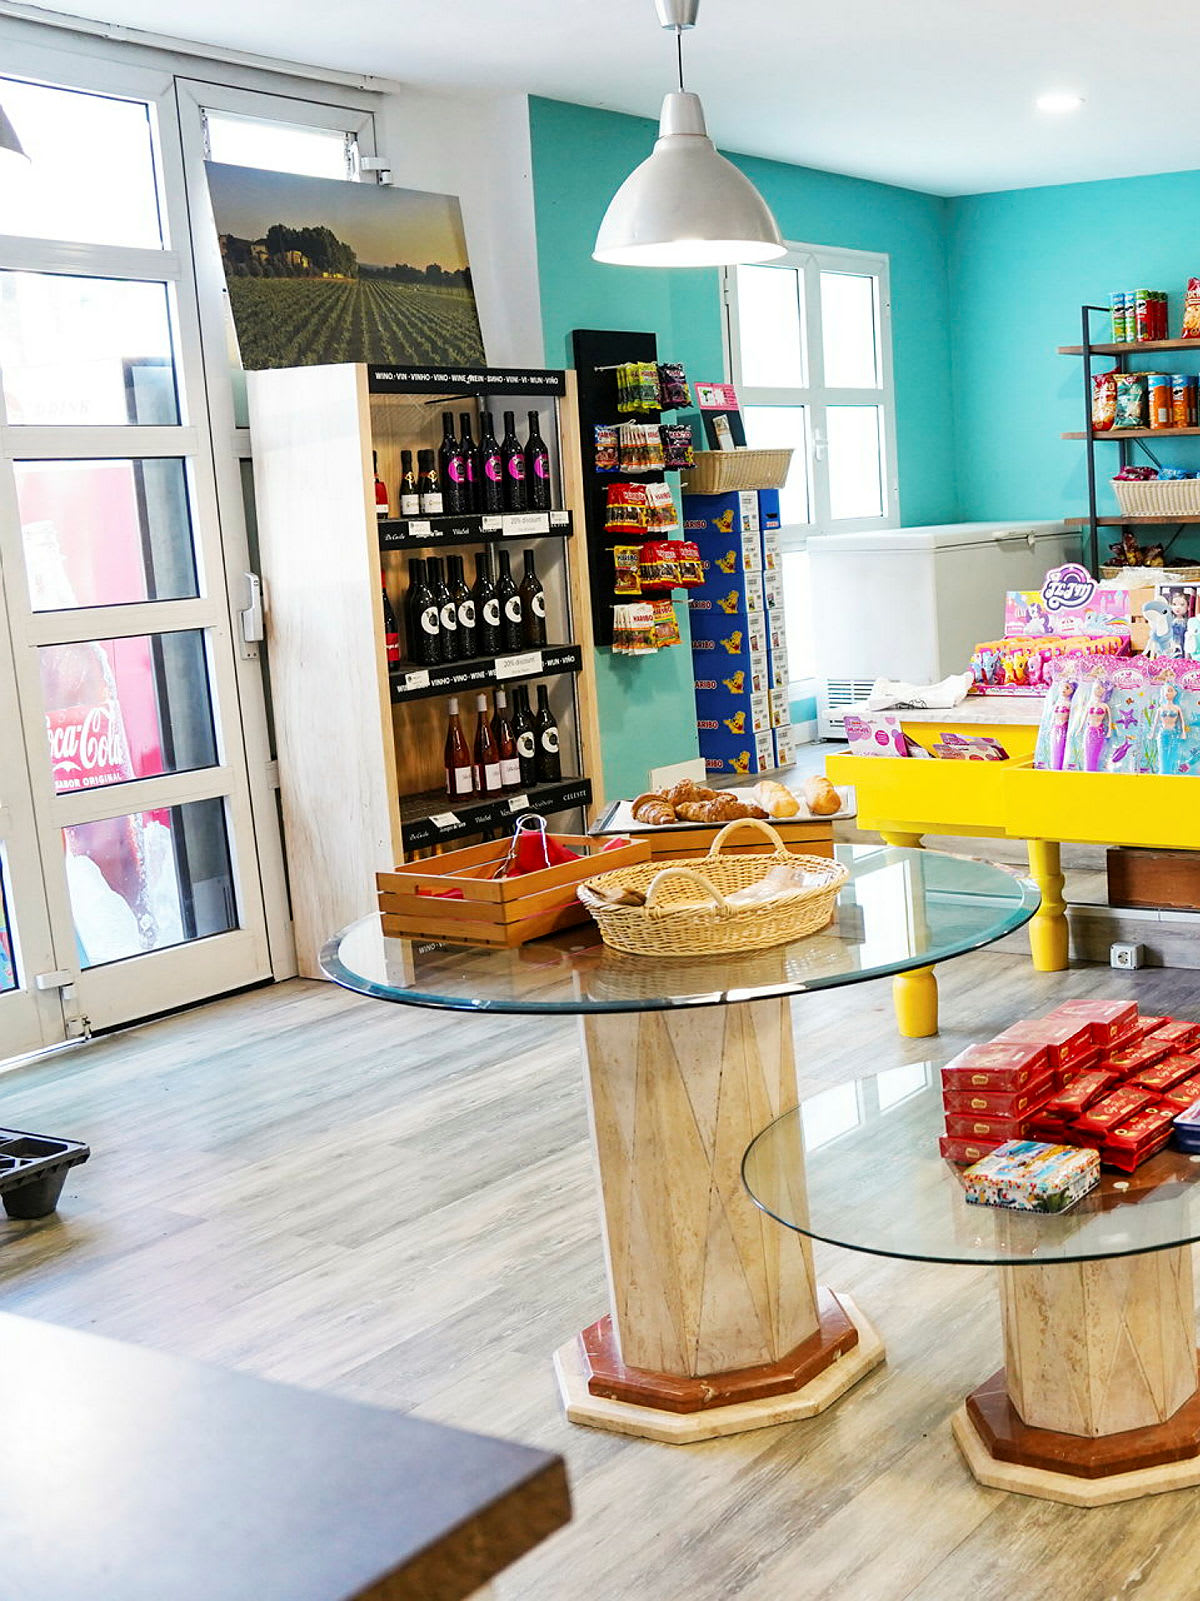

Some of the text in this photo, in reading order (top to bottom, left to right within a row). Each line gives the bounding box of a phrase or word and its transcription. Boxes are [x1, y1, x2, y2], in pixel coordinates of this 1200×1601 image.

[396, 372, 408, 380] VIN
[410, 373, 430, 381] VINHO
[433, 374, 448, 382] VINO
[452, 374, 466, 382] WINE
[633, 614, 654, 622] HARIBO
[504, 658, 516, 668] 20%
[431, 678, 450, 687] VINHO
[453, 675, 468, 685] VINO
[470, 672, 484, 682] WINE
[694, 680, 718, 690] ARIBO
[696, 720, 720, 730] ARIBO
[82, 773, 122, 786] ORIGINAL
[562, 790, 586, 802] CELESTE
